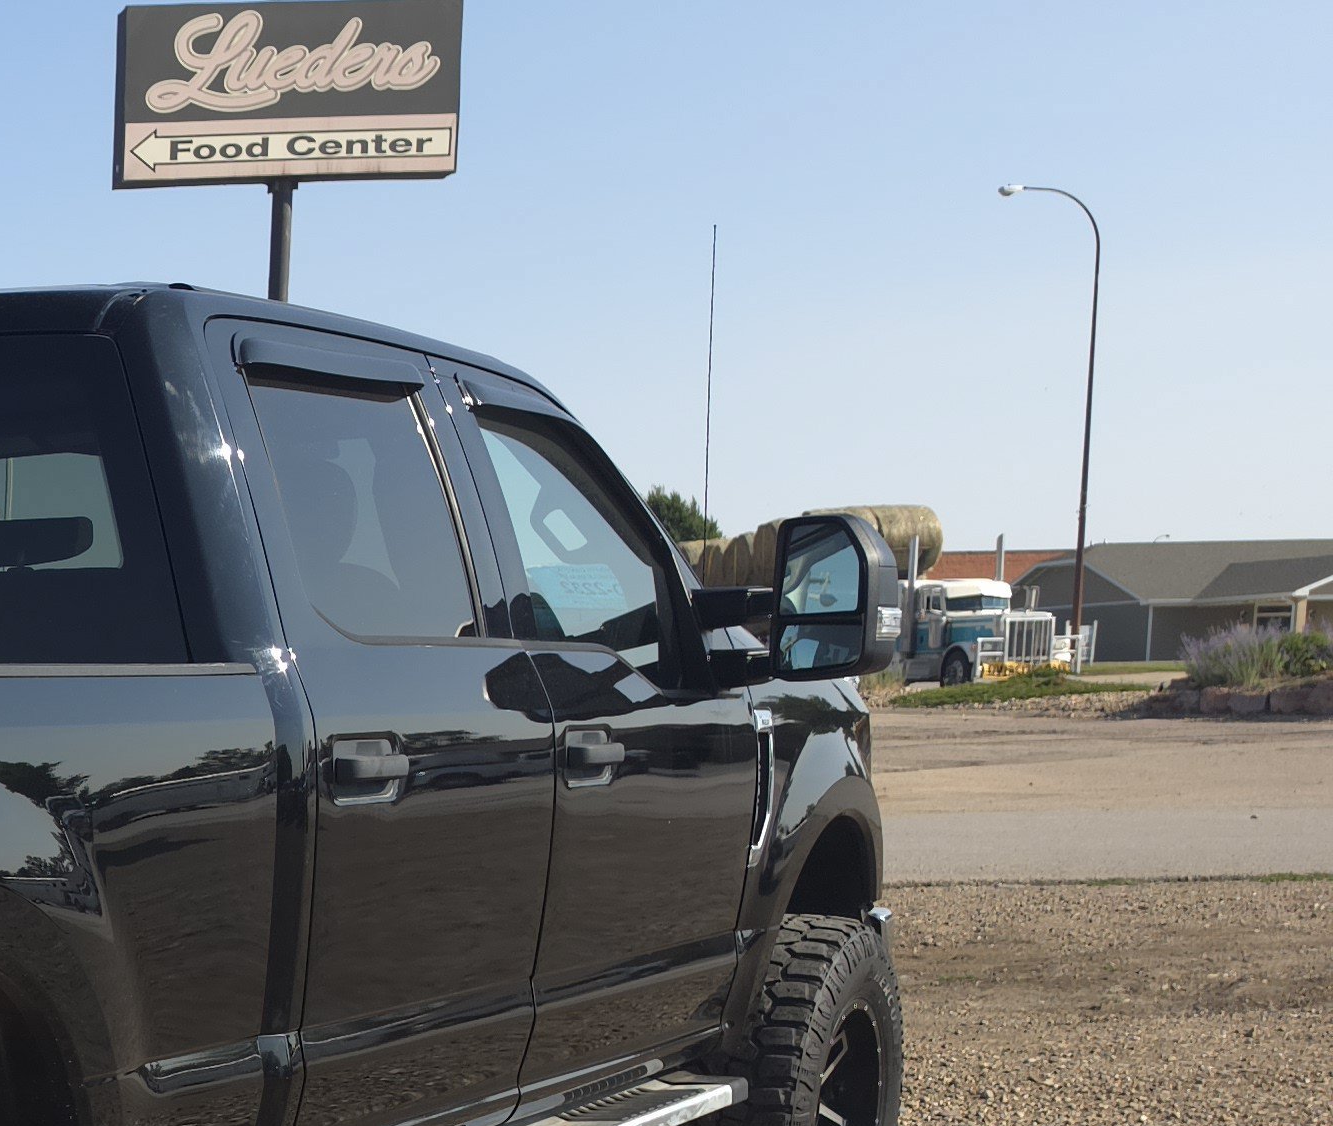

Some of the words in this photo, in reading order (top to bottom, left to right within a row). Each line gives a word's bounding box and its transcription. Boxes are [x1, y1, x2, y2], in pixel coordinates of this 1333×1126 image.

[145, 9, 440, 113] Lueders
[168, 136, 270, 161] Food
[286, 133, 433, 156] Center
